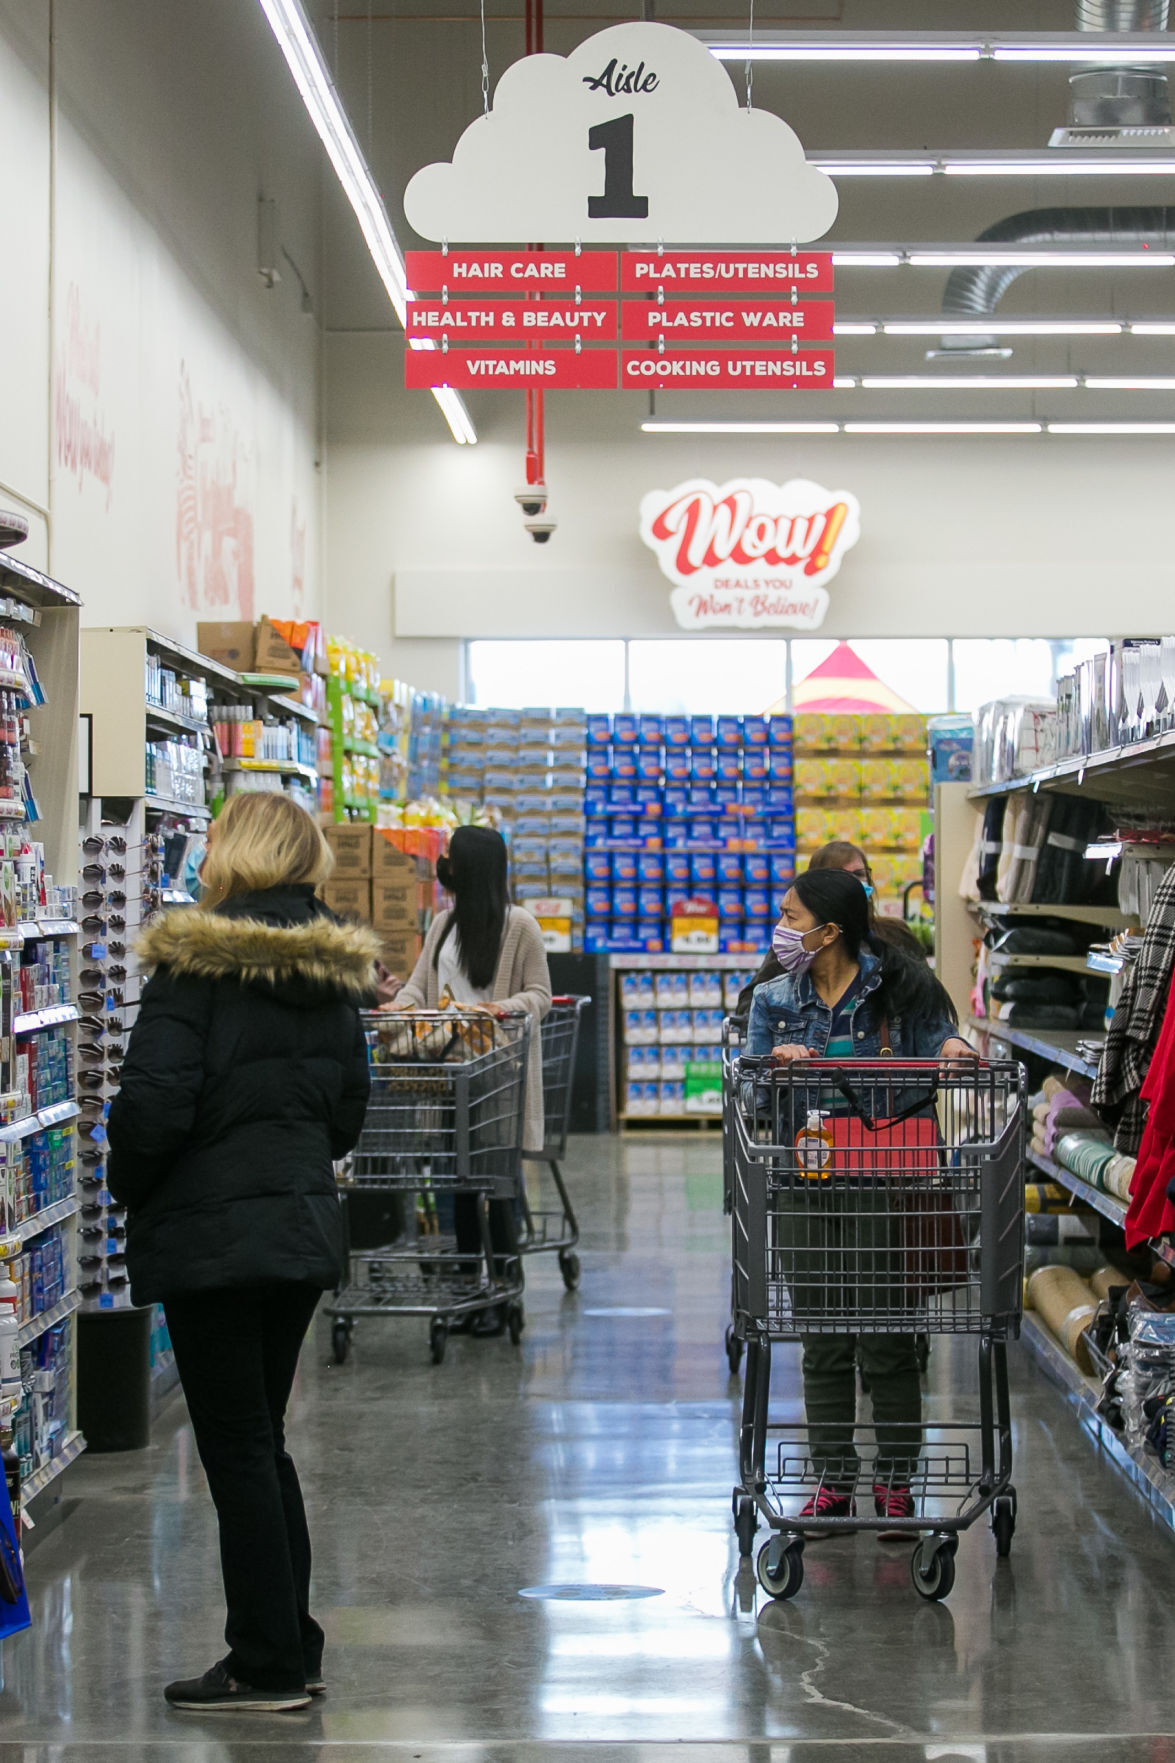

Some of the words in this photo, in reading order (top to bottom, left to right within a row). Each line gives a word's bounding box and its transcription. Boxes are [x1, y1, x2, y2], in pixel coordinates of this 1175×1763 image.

[583, 58, 660, 97] Aisle
[588, 113, 649, 219] 1
[453, 262, 504, 278] HAIR
[511, 262, 566, 279] CARE
[635, 263, 819, 279] PLATES/UTENSILS
[412, 311, 495, 327] HEALTH
[502, 311, 516, 327] &
[523, 311, 607, 327] BEAUTY
[648, 311, 735, 328] PLASTIC
[742, 311, 805, 327] WARE
[467, 359, 557, 376] VITAMINS
[627, 360, 721, 376] COOKING
[727, 360, 827, 377] UTENSILS
[652, 490, 848, 576] Wow!
[714, 578, 761, 590] DEALS
[764, 578, 793, 590] YOU
[688, 593, 744, 618] Won't
[749, 593, 819, 619] Believe!
